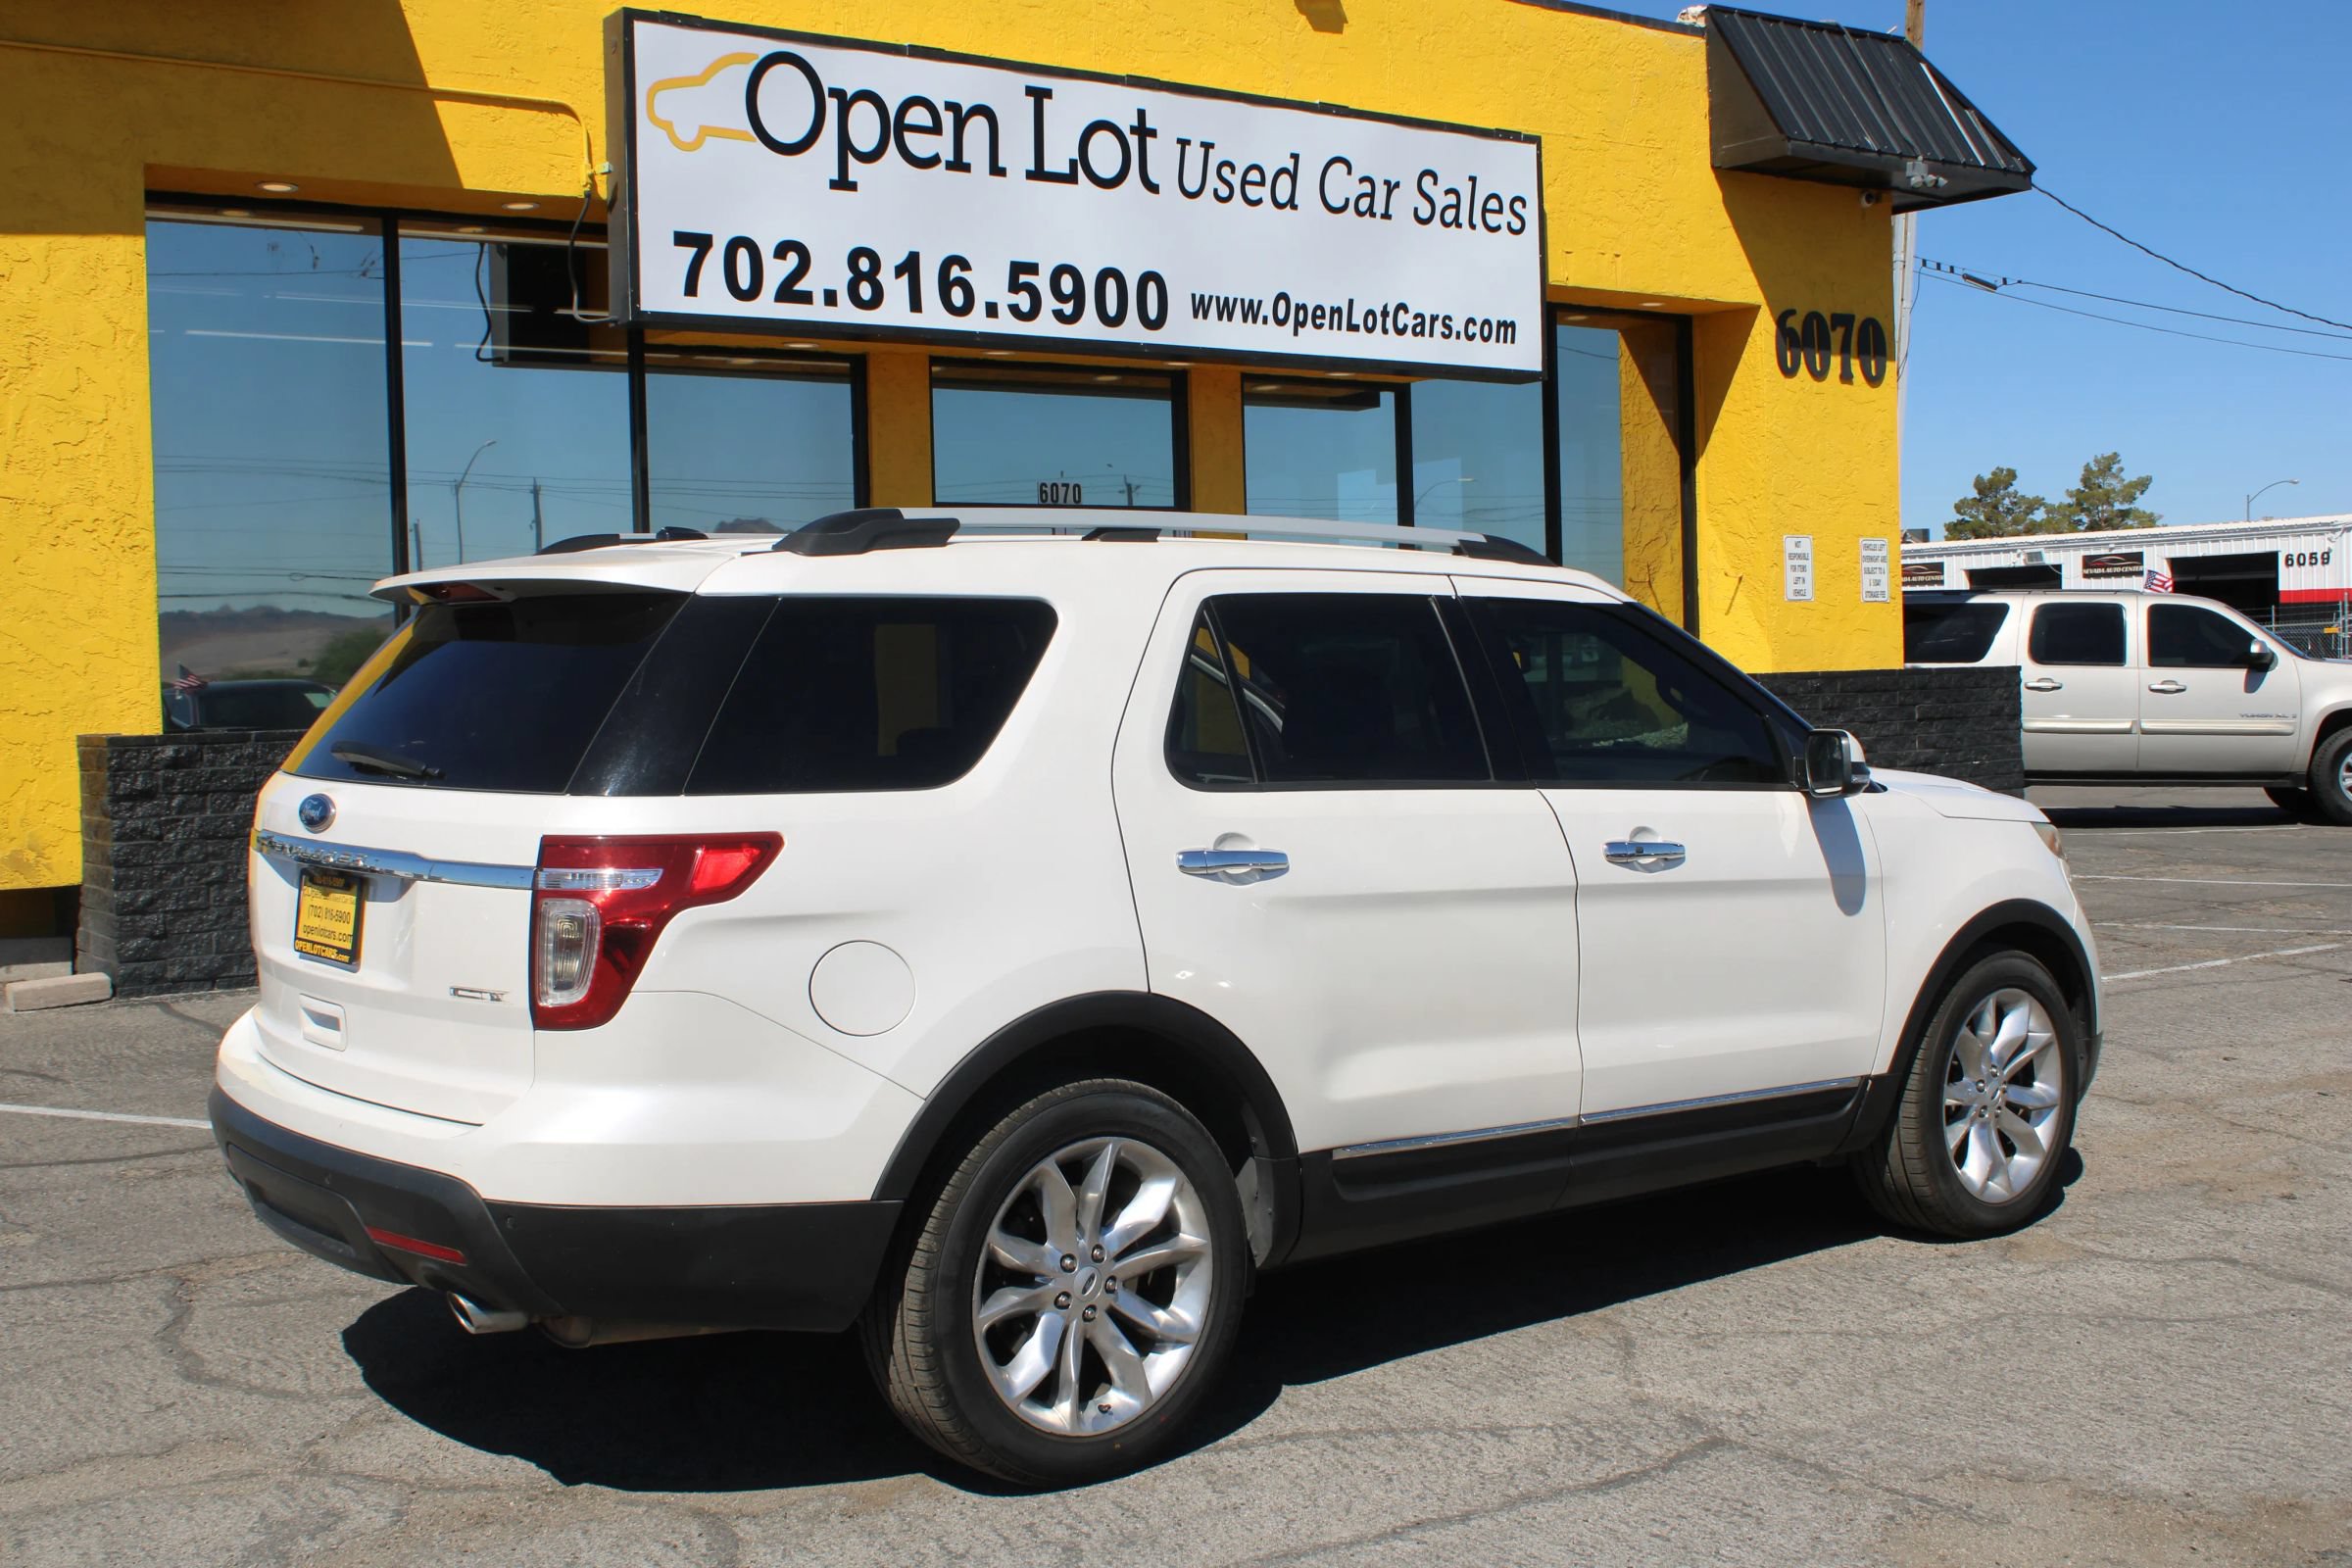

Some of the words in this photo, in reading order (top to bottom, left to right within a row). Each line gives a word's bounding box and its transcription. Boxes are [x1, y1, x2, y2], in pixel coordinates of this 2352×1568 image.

[745, 51, 1007, 192] Open
[1024, 85, 1160, 195] Lot
[1176, 137, 1299, 211] Used
[1319, 156, 1400, 220] Car
[1413, 169, 1527, 235] Sales
[673, 230, 1169, 331] 702.816.5900
[1191, 291, 1516, 345] www.OpenLotCars.com
[1776, 309, 1887, 388] 6070
[1039, 482, 1082, 505] 6070
[2284, 551, 2330, 567] 6059
